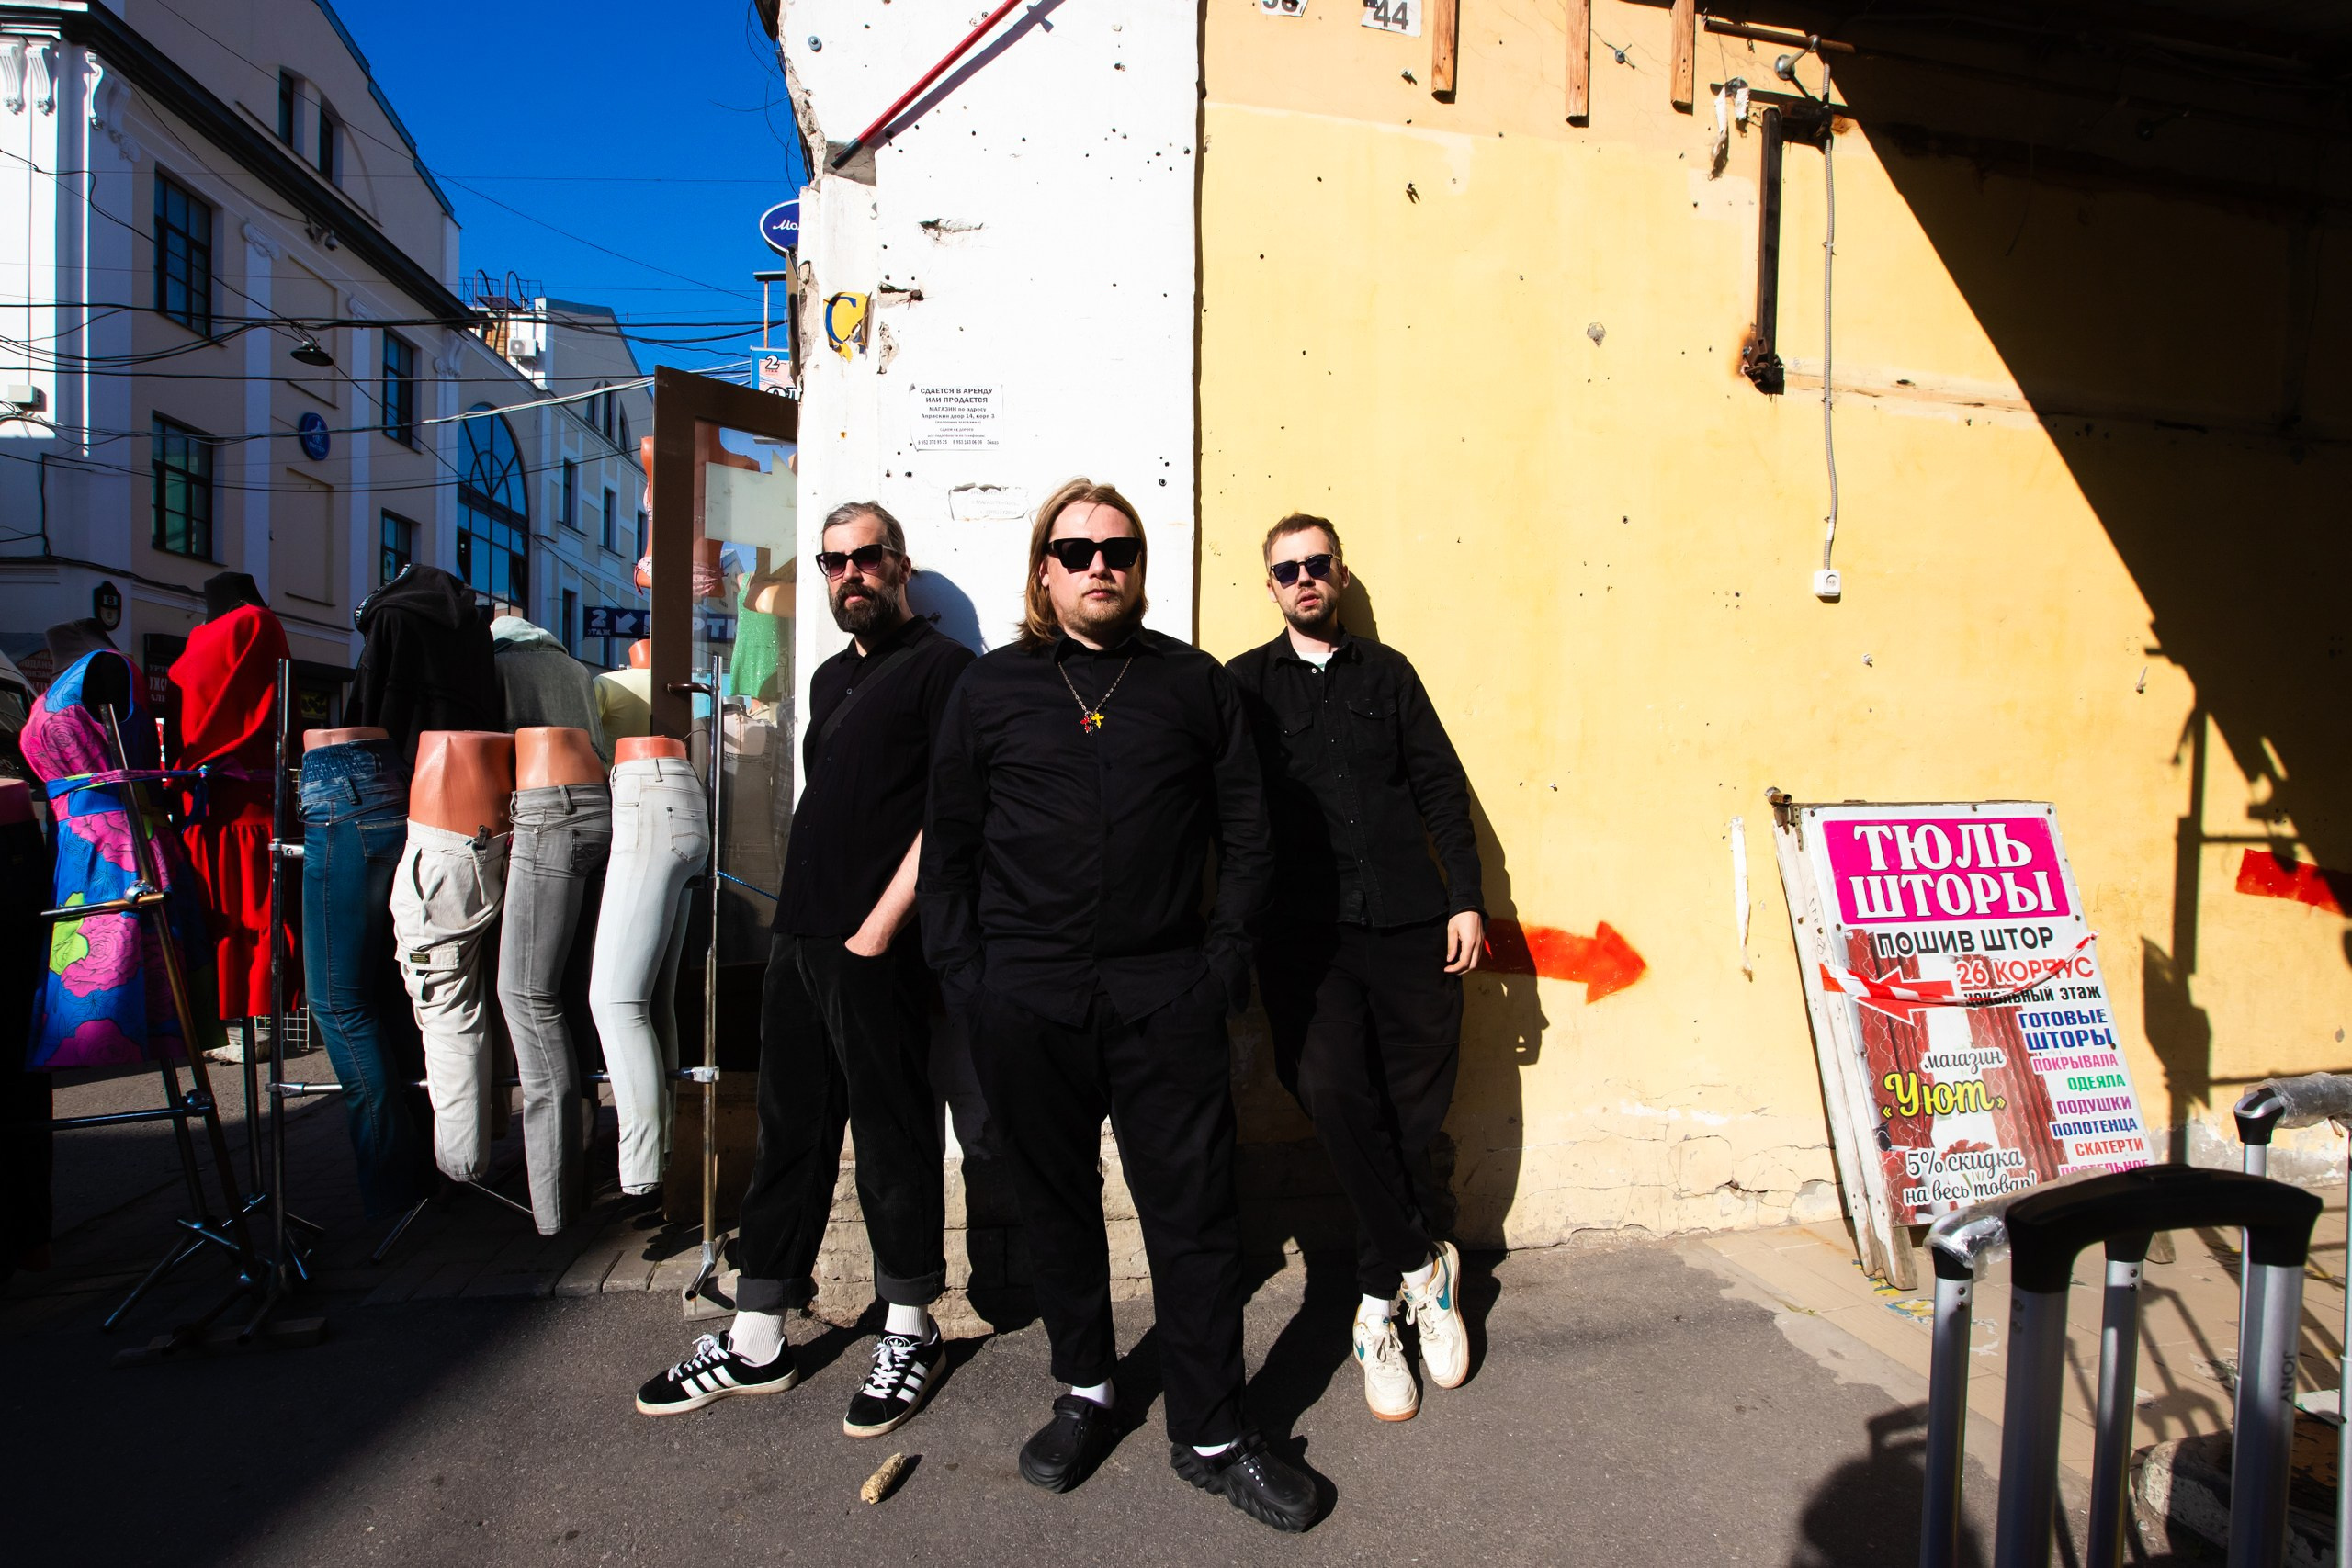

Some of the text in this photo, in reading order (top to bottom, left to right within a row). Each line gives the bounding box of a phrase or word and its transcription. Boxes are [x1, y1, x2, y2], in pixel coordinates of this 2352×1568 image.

[772, 219, 799, 230] Мо
[765, 355, 780, 369] 2
[107, 595, 115, 604] 8
[591, 609, 607, 627] 2
[1854, 823, 2032, 871] ТЮЛЬ
[1849, 871, 2057, 919] ШТОРЫ
[1877, 926, 2053, 956] ПОШИВ ШТОР
[1956, 963, 1986, 985] 26
[2061, 986, 2101, 1000] этаж
[2018, 1009, 2108, 1029] ГОТОВЫЕ
[2025, 1028, 2113, 1050] ШТОРЫ
[1925, 1051, 2004, 1074] магазин
[2033, 1054, 2119, 1072] ПОКРЫВАЛА
[2067, 1074, 2126, 1091] ОДЕЯЛА
[2056, 1096, 2132, 1115] ПОДУШКИ
[2052, 1117, 2138, 1136] ПОЛОТЕНЦА
[2075, 1138, 2144, 1156] СКАТЕРТИ
[1907, 1150, 2023, 1179] 5% скидка
[1905, 1188, 1928, 1203] на
[1933, 1179, 1969, 1201] весь
[2281, 1351, 2295, 1403] JONY
